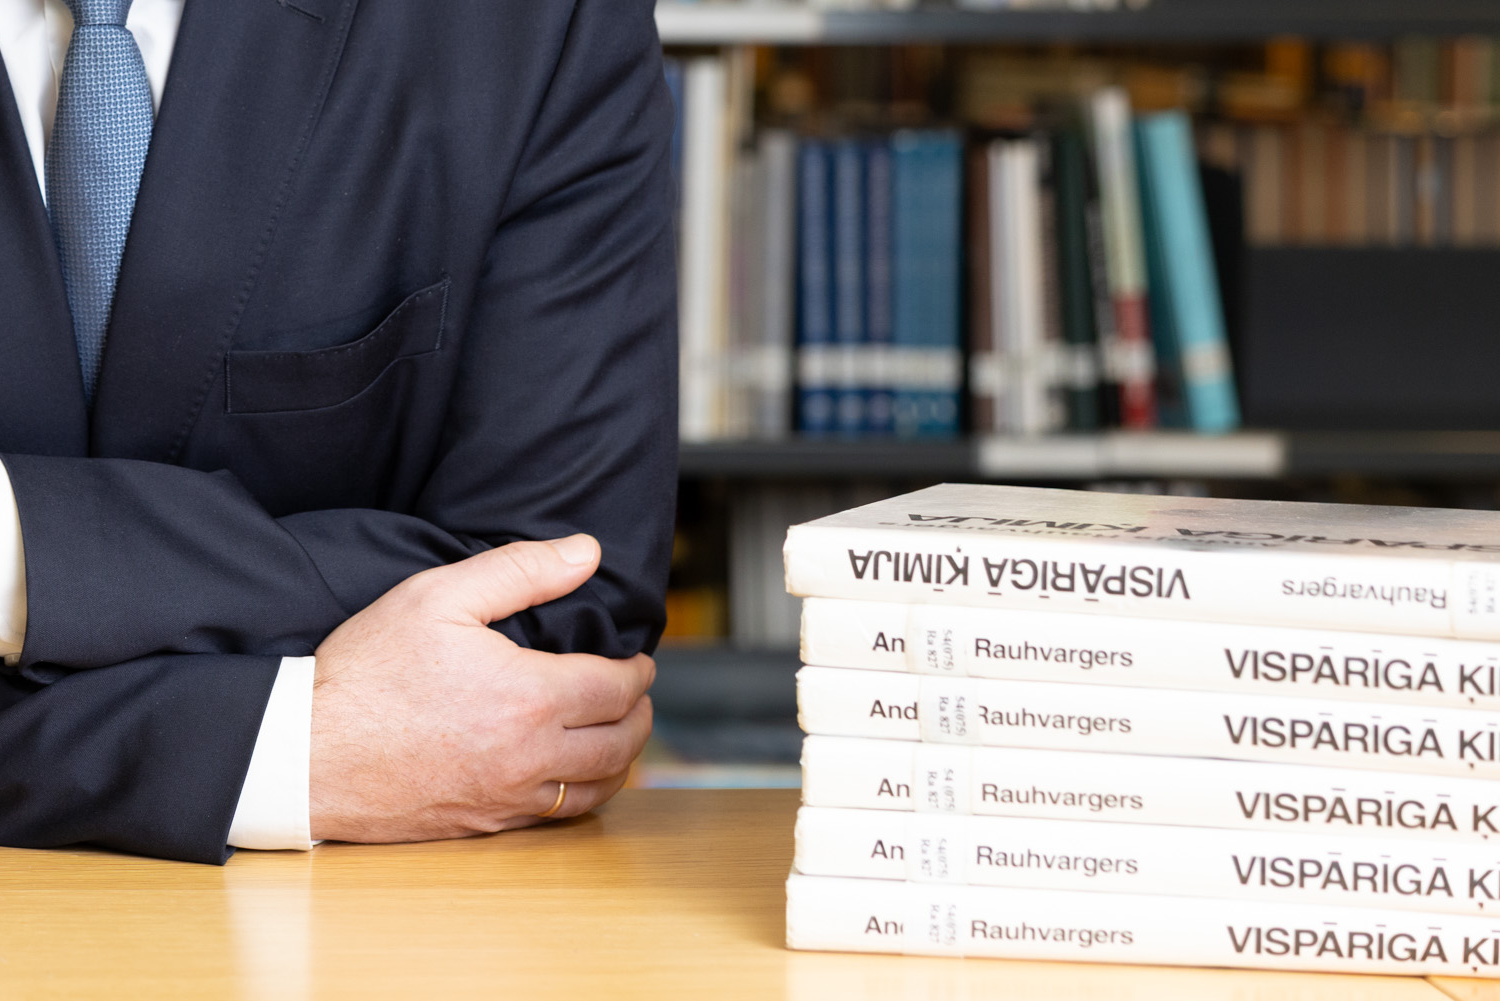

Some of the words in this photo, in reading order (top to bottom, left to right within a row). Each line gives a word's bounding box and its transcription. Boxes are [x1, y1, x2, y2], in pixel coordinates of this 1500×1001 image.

[848, 546, 970, 593] ĶĪMIJA
[983, 557, 1190, 601] VISPĀRĪGĀ
[1282, 577, 1446, 609] Rauhvargers
[873, 632, 905, 652] An
[975, 638, 1132, 669] Rauhvargers
[1224, 646, 1445, 693] VISPĀRĪGĀ
[1458, 657, 1500, 704] ĶĪ
[870, 700, 918, 720] And
[1222, 712, 1445, 759] VISPĀRĪGĀ
[1458, 723, 1500, 769] ĶĪ
[878, 779, 910, 797] An
[982, 784, 1143, 811] Rauhvargers
[1235, 787, 1459, 832] VISPĀRĪGĀ
[871, 840, 903, 859] An
[977, 846, 1138, 876] Rauhvargers
[1231, 852, 1454, 898] VISPĀRĪGĀ
[865, 916, 903, 934] An
[972, 920, 1133, 947] Rauhvargers
[1227, 921, 1449, 964] VISPĀRĪGĀ
[1462, 930, 1500, 972] ĶĪ
